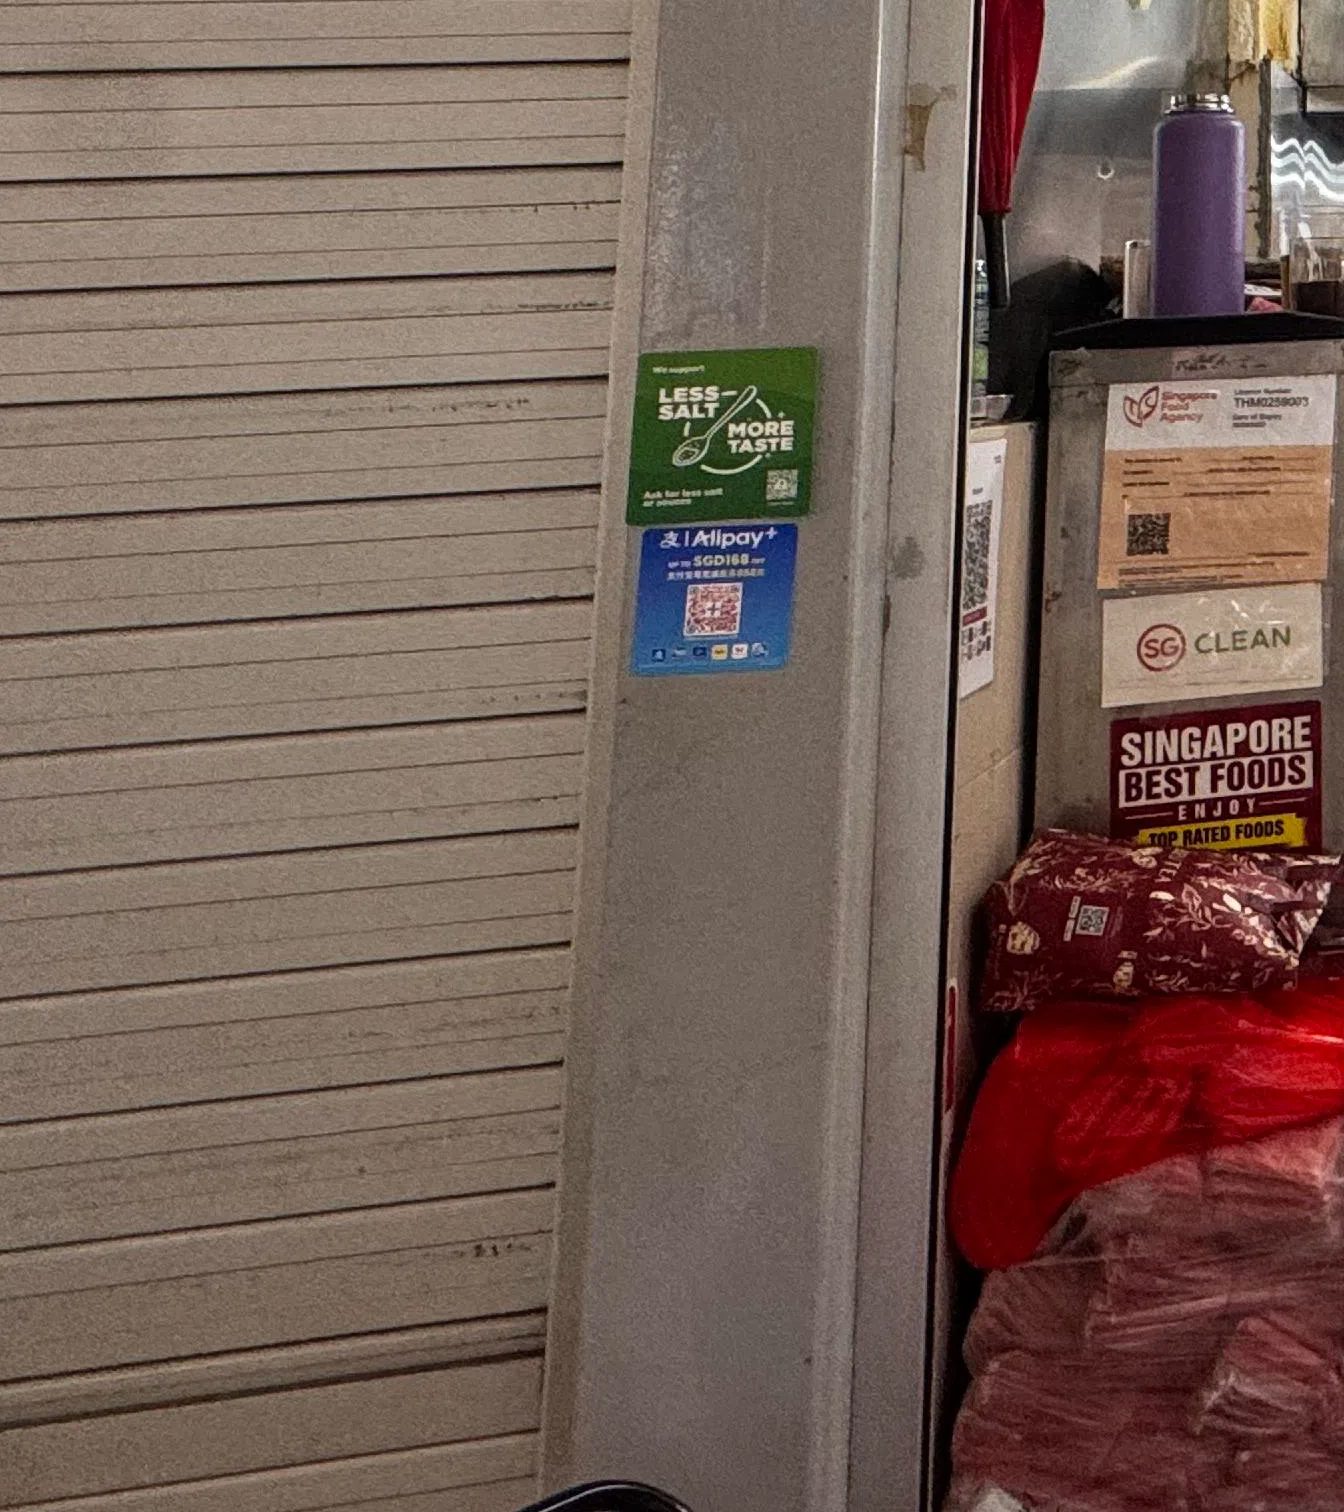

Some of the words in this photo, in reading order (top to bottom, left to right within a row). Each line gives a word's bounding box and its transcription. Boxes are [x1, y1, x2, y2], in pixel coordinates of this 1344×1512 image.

[658, 386, 720, 403] LESS
[658, 402, 720, 420] SALT
[727, 420, 794, 438] MORE
[727, 437, 794, 454] TASTE
[1143, 638, 1178, 658] SG
[1195, 626, 1291, 655] CLEAN
[1120, 715, 1312, 767] SINGAPORE
[1124, 766, 1200, 803] BEST
[1210, 754, 1306, 793] FOODS
[1178, 798, 1257, 820] ENJOY
[1148, 829, 1178, 846] TOP
[1183, 824, 1231, 846] RATED
[1235, 819, 1284, 840] FOODS
